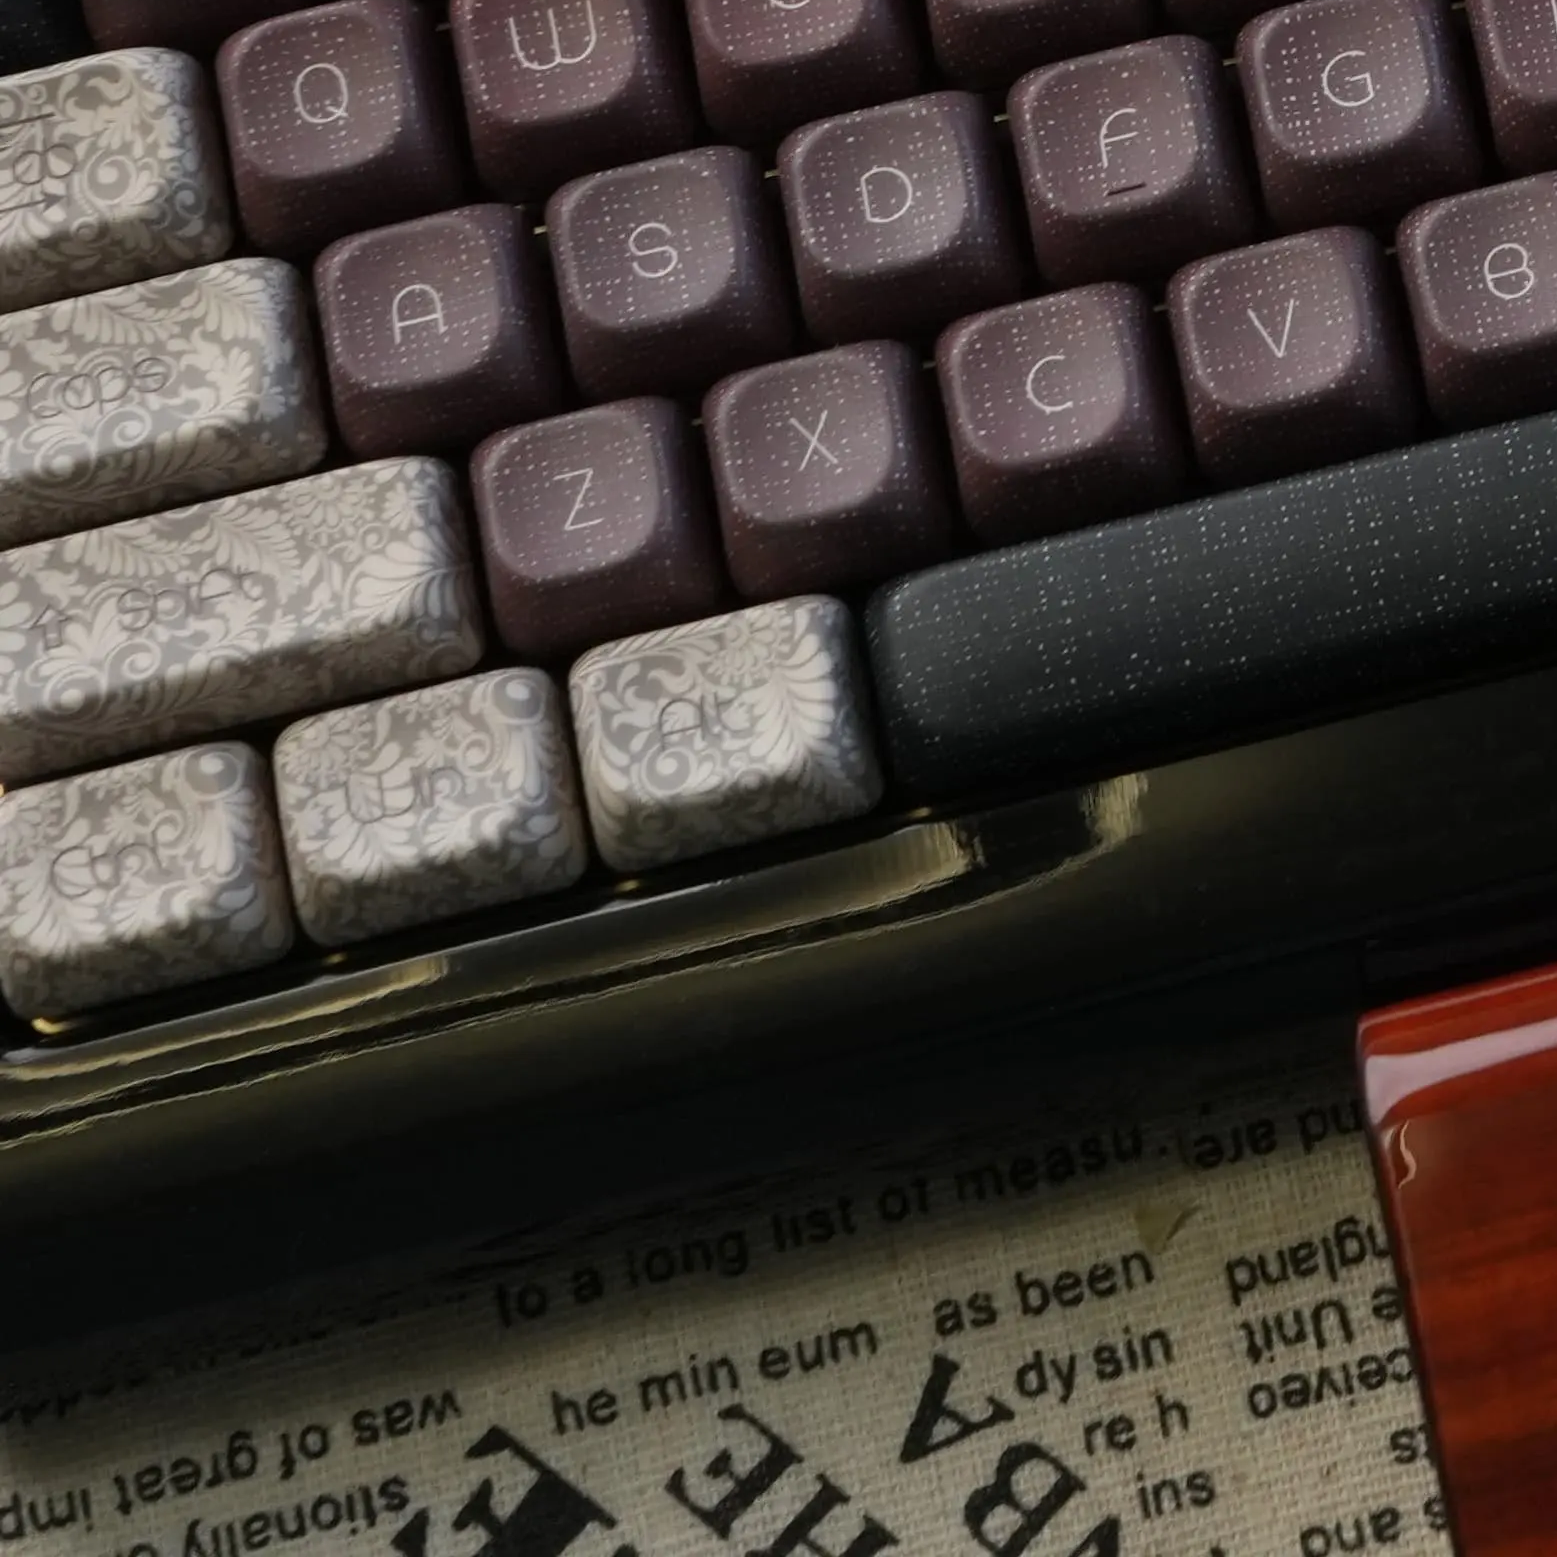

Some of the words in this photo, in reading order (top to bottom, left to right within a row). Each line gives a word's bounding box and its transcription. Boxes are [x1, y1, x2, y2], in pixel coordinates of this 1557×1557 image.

[294, 62, 348, 125] Q
[1321, 50, 1377, 108] G
[858, 166, 914, 223] D
[628, 222, 679, 279] S
[392, 284, 447, 344] A
[555, 468, 604, 532] Z
[934, 1288, 999, 1336] as
[1016, 1247, 1155, 1316] been
[1238, 1299, 1355, 1363] Unit
[639, 1355, 738, 1413] min
[758, 1322, 878, 1383] eum
[352, 1390, 461, 1449] was
[114, 1430, 260, 1513] great
[280, 1422, 331, 1482] of
